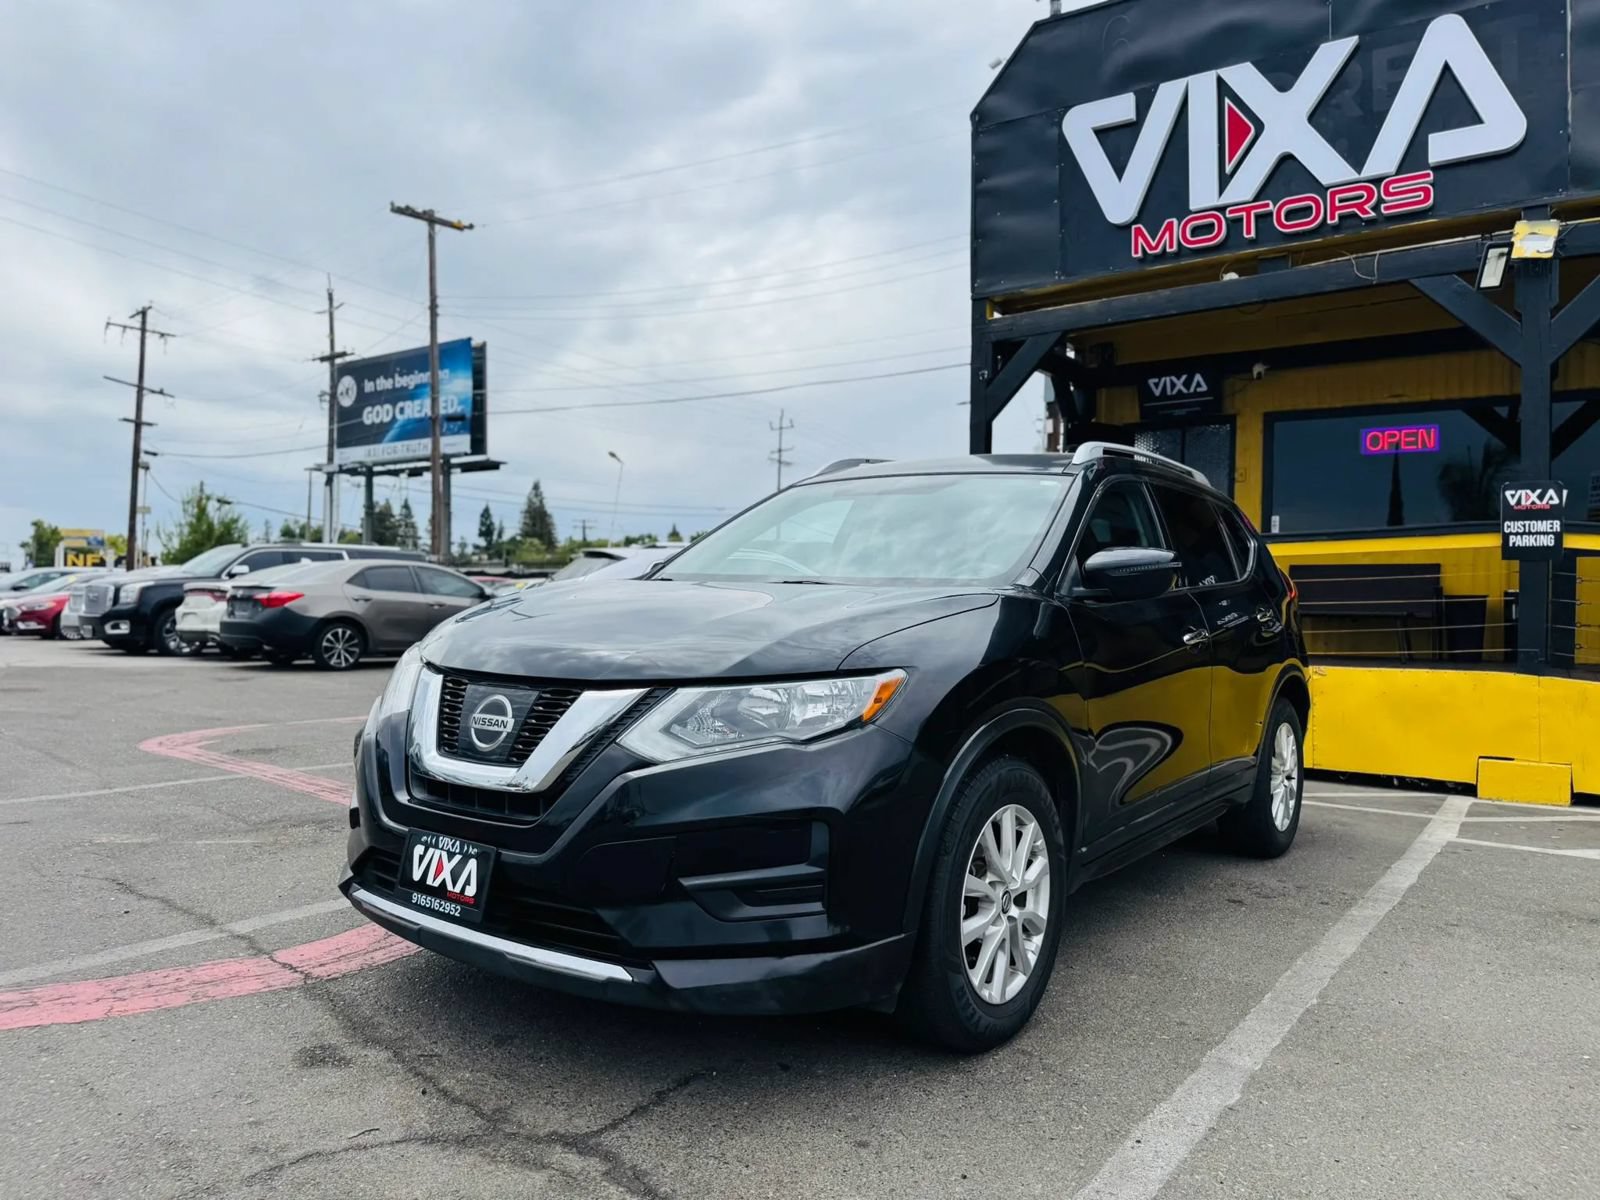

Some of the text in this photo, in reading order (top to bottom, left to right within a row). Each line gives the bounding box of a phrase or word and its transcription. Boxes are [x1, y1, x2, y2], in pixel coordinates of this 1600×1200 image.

[1062, 13, 1527, 225] VIXA
[1131, 171, 1434, 258] MOTORS
[364, 379, 375, 393] In
[376, 376, 394, 391] the
[1148, 373, 1208, 396] VIXA
[362, 403, 394, 425] GOD
[1366, 428, 1435, 451] OPEN
[1504, 488, 1560, 506] VIXA
[1504, 520, 1560, 533] CUSTOMER
[1509, 534, 1555, 547] PARKING
[471, 716, 509, 729] NISSAN
[412, 843, 477, 897] VIXA
[411, 892, 461, 917] 9165162952
[447, 891, 475, 904] MOTORS
